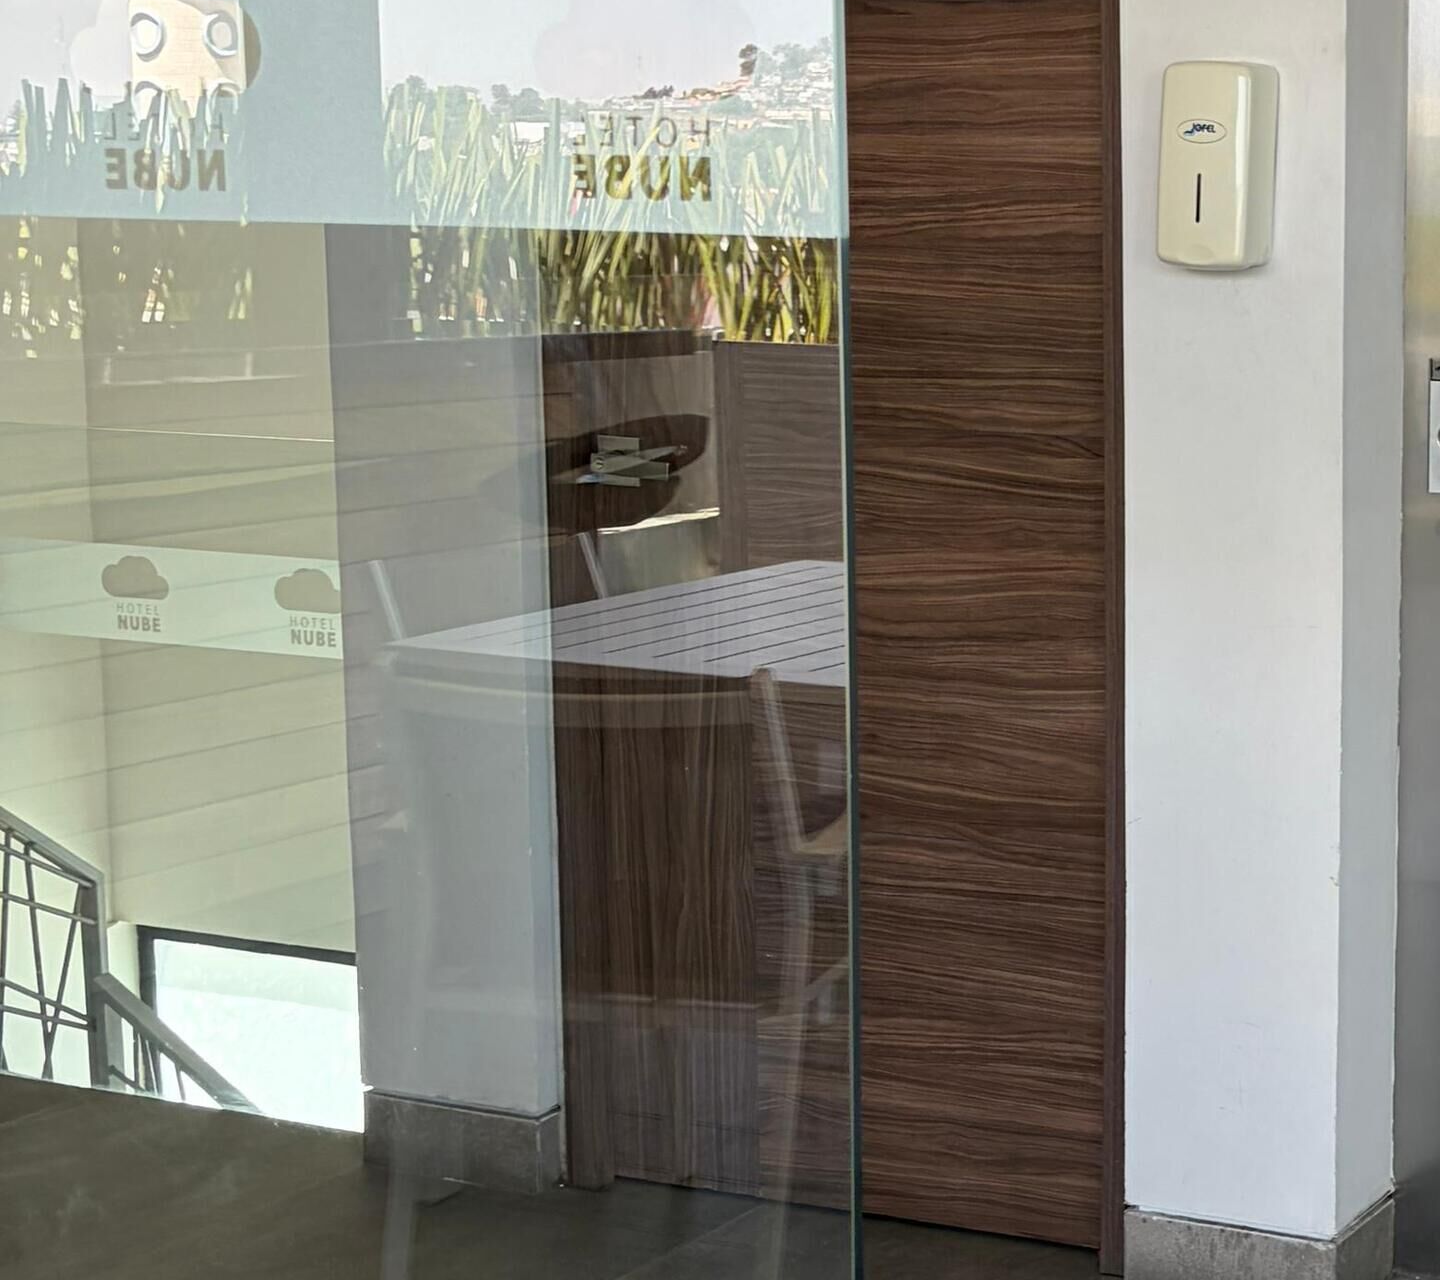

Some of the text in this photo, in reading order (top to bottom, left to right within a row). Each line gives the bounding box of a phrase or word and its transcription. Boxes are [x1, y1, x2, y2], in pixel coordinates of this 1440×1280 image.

[116, 602, 160, 616] HOTEL
[117, 614, 161, 632] NUBE
[290, 615, 336, 630] HOTEL
[291, 628, 337, 648] NUBE
